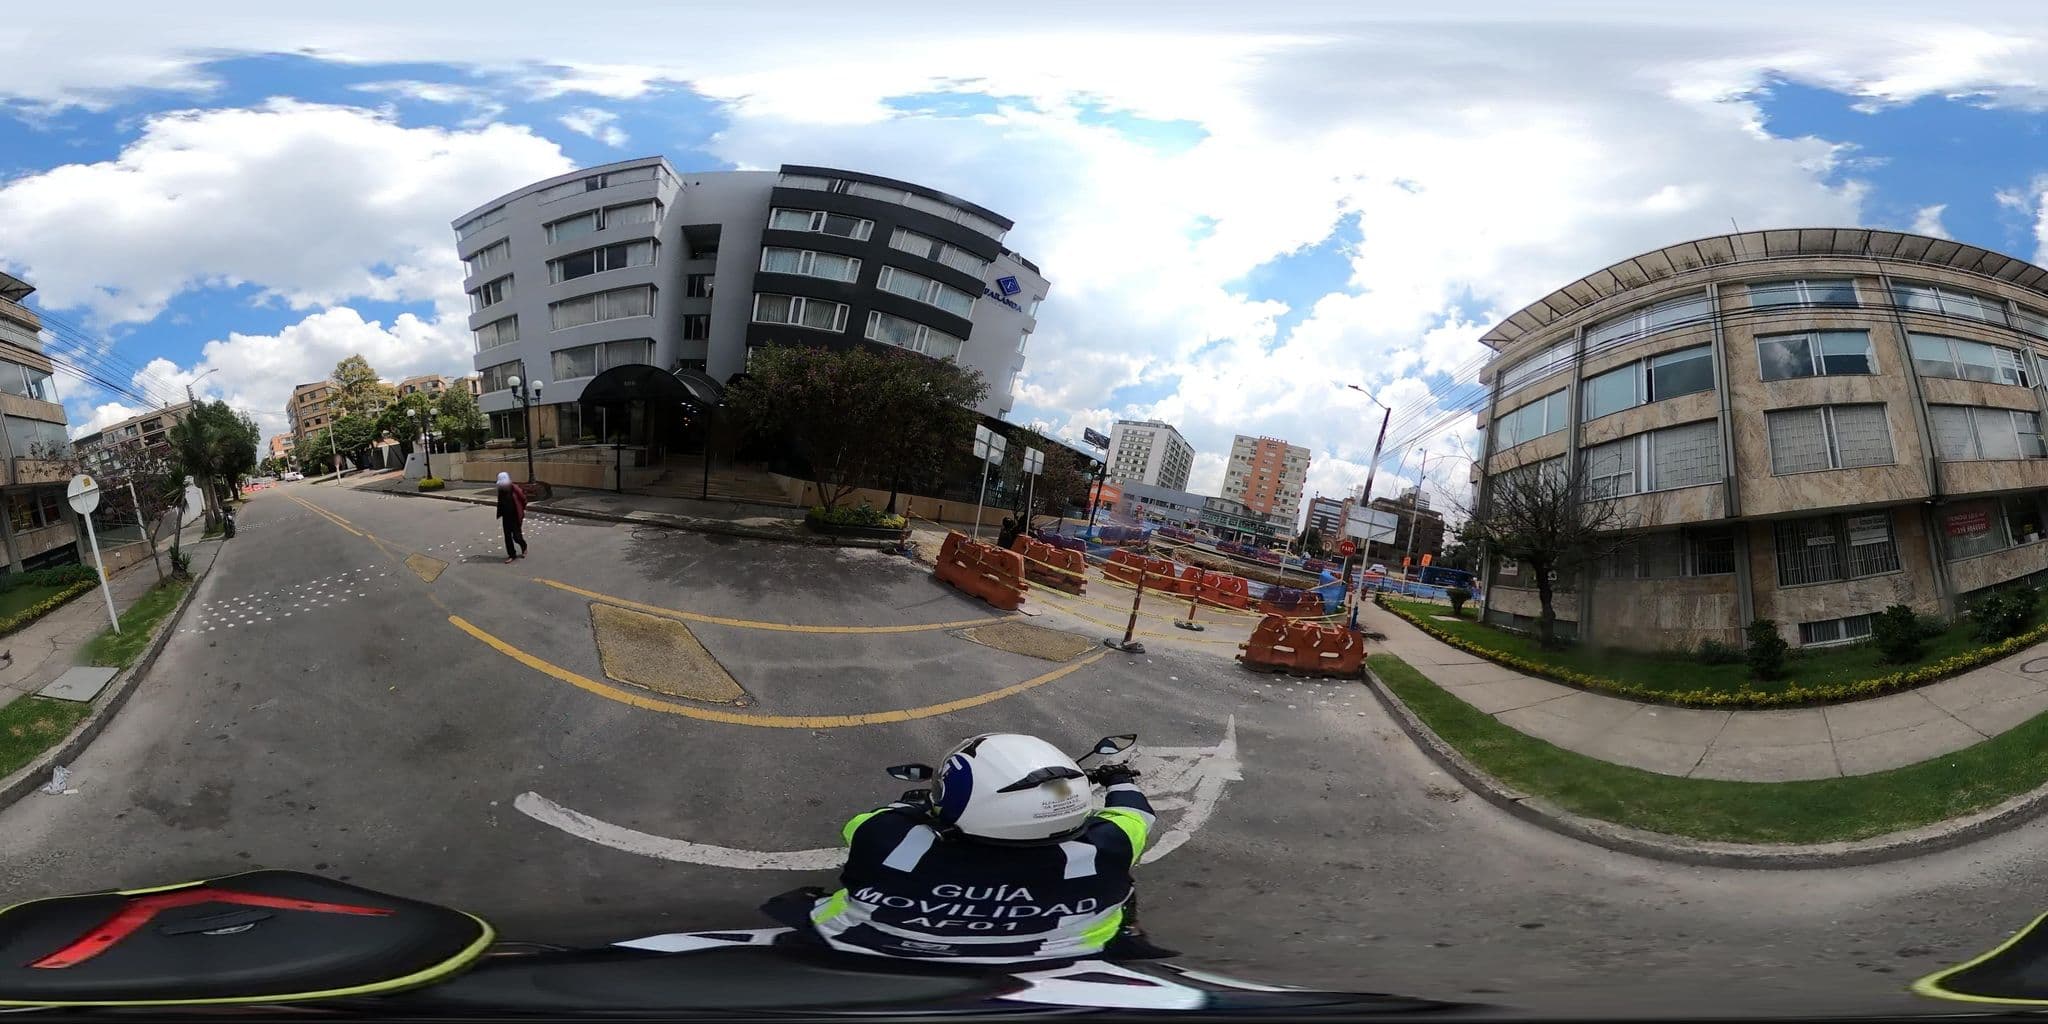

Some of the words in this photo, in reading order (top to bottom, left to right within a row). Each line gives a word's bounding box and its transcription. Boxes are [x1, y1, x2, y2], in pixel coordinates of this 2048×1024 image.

[931, 884, 1034, 902] GUÍA
[855, 887, 1097, 918] MOVILIDAD
[902, 917, 1018, 931] AF01
